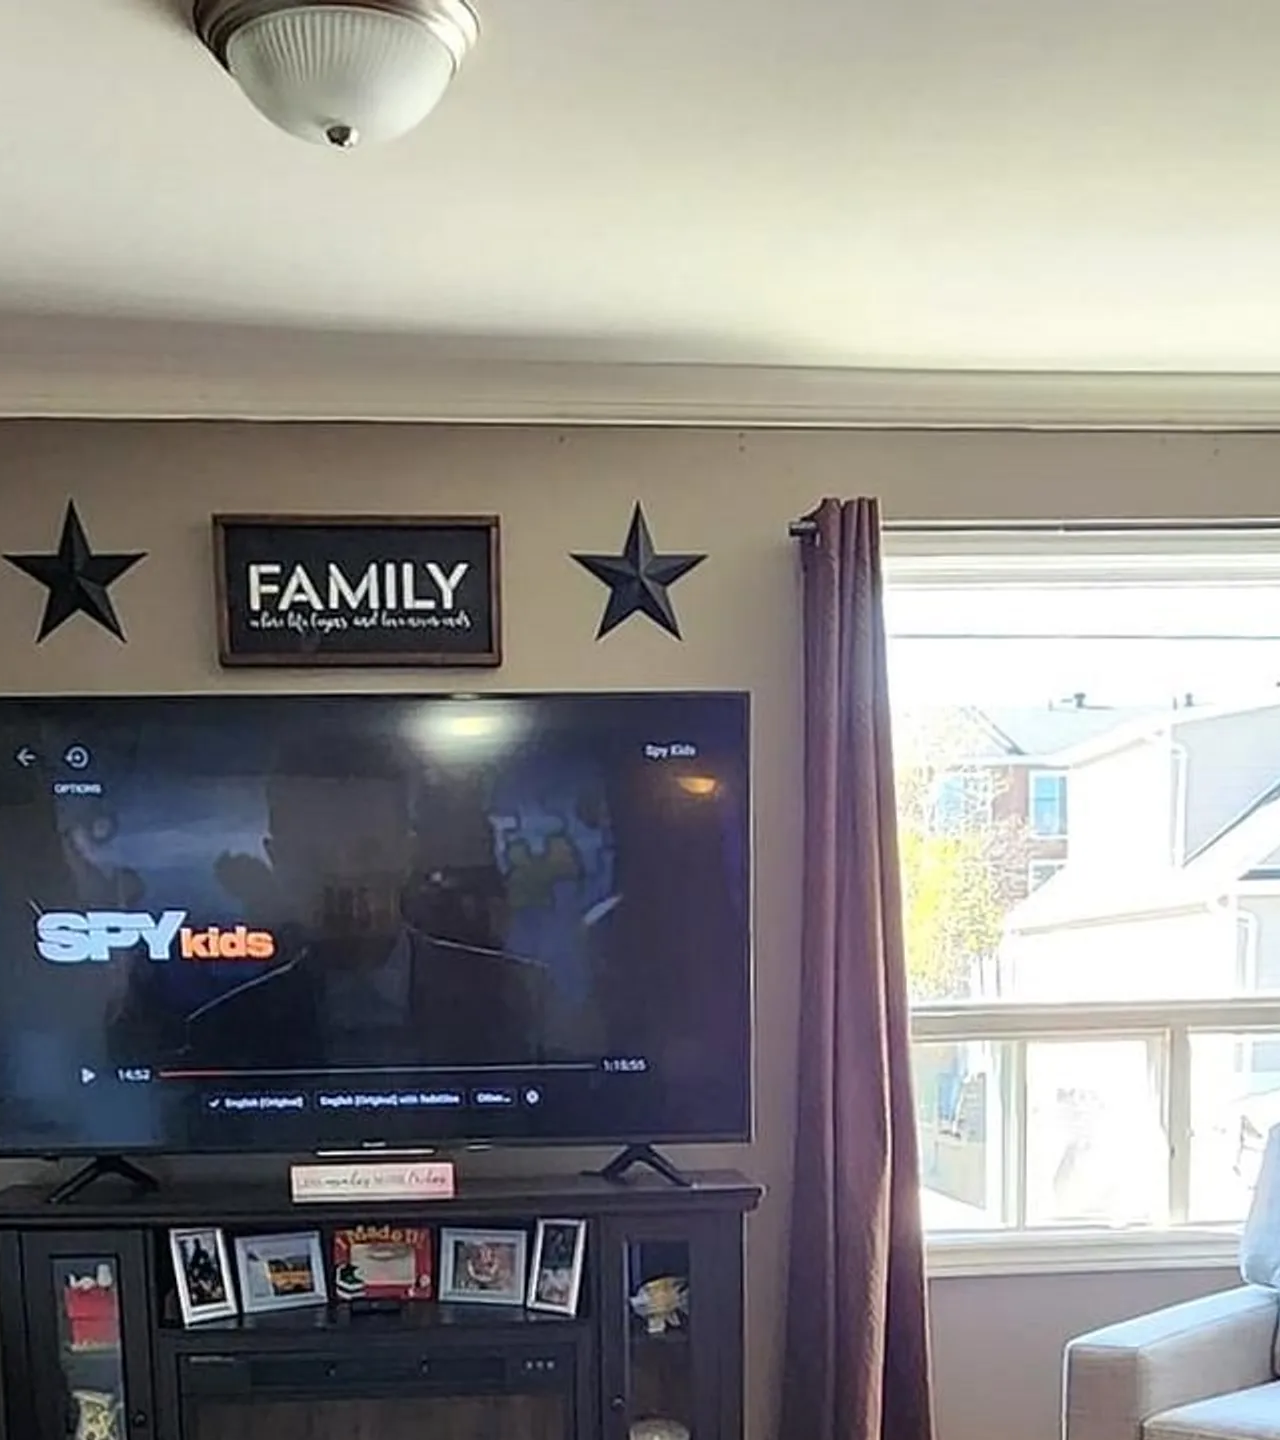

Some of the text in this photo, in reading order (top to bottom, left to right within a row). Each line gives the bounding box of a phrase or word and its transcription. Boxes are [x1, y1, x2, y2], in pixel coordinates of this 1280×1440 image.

[248, 562, 469, 611] FAMILY
[645, 744, 668, 759] Spy
[54, 783, 102, 794] OPTIONS
[36, 910, 274, 962] SPY kids
